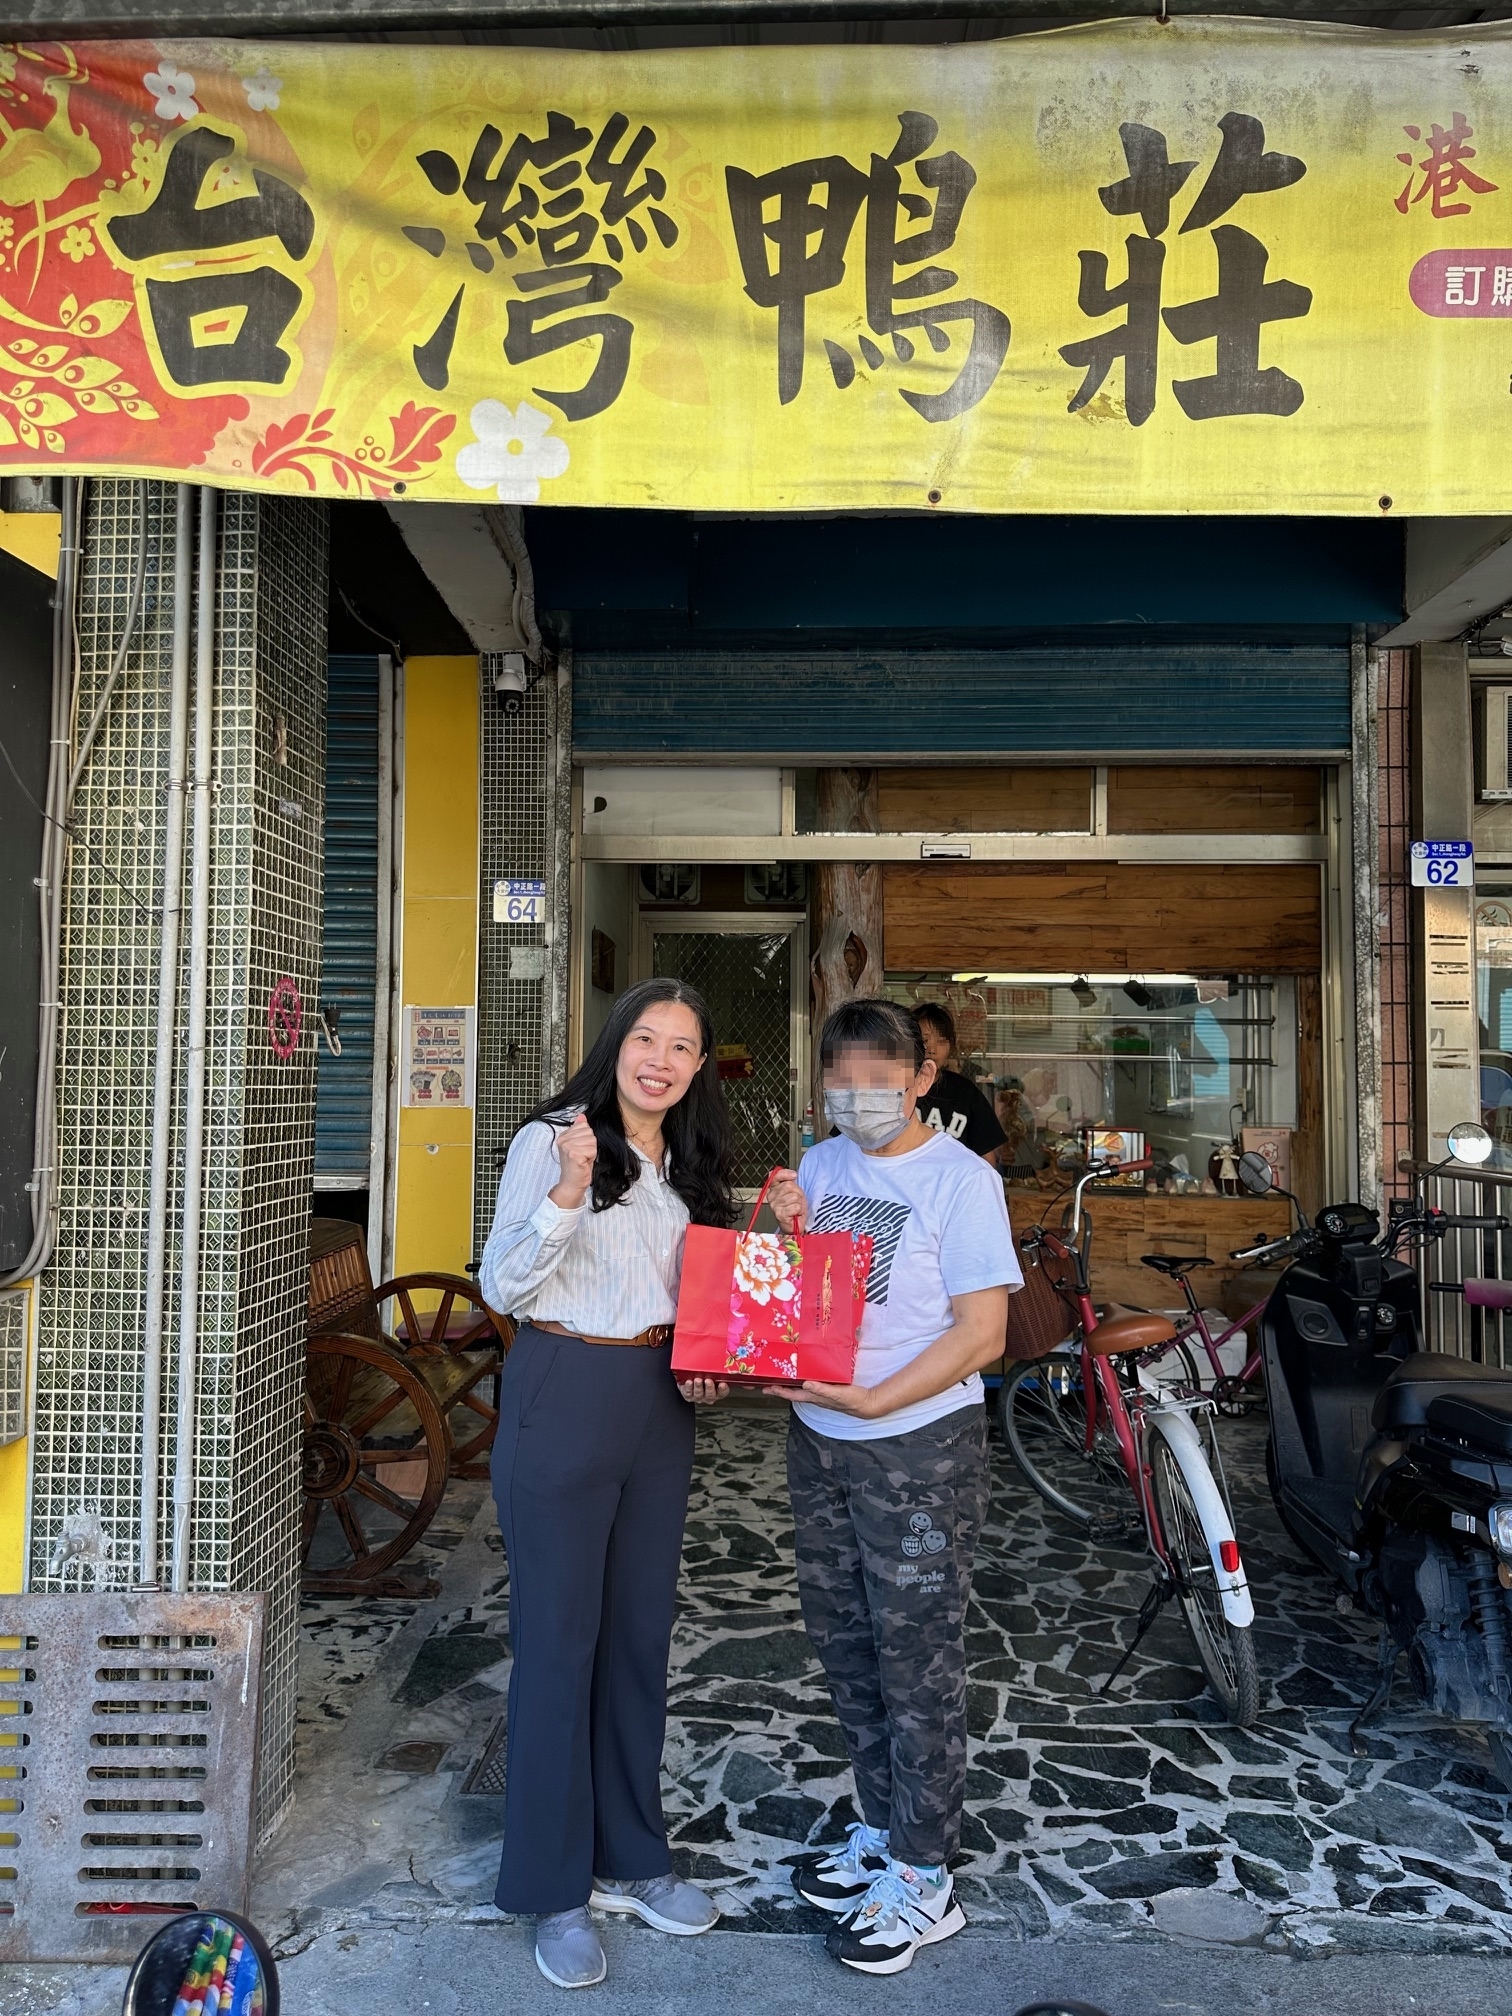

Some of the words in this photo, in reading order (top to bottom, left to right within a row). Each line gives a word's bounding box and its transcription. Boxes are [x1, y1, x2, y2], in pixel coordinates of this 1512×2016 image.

[1394, 111, 1500, 219] 港
[105, 111, 1313, 426] 台灣鴨莊
[1432, 844, 1466, 852] 中正路一段
[1427, 860, 1459, 885] 62
[508, 898, 537, 922] 64
[896, 1570, 946, 1587] people
[897, 1564, 918, 1574] my
[919, 1585, 942, 1593] are
